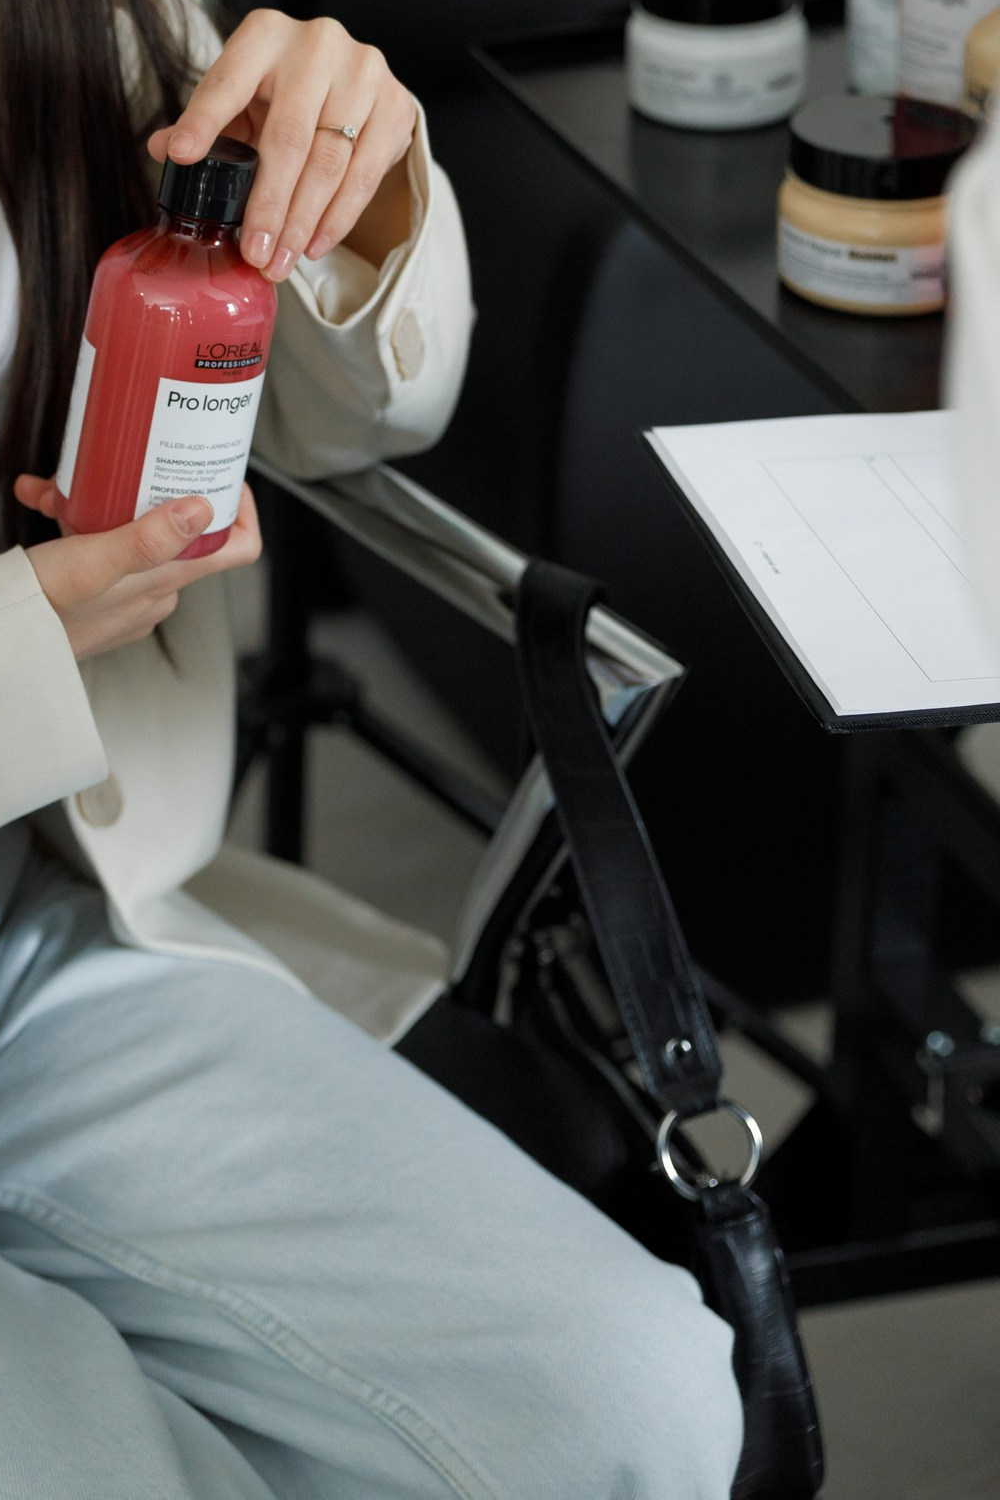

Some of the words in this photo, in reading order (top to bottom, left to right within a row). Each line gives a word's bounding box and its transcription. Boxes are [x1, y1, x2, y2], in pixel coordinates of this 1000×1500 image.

[167, 391, 199, 411] Pro
[202, 393, 253, 414] longer
[156, 457, 206, 467] SHAMPOOING
[150, 485, 207, 495] PROFESSIONAL
